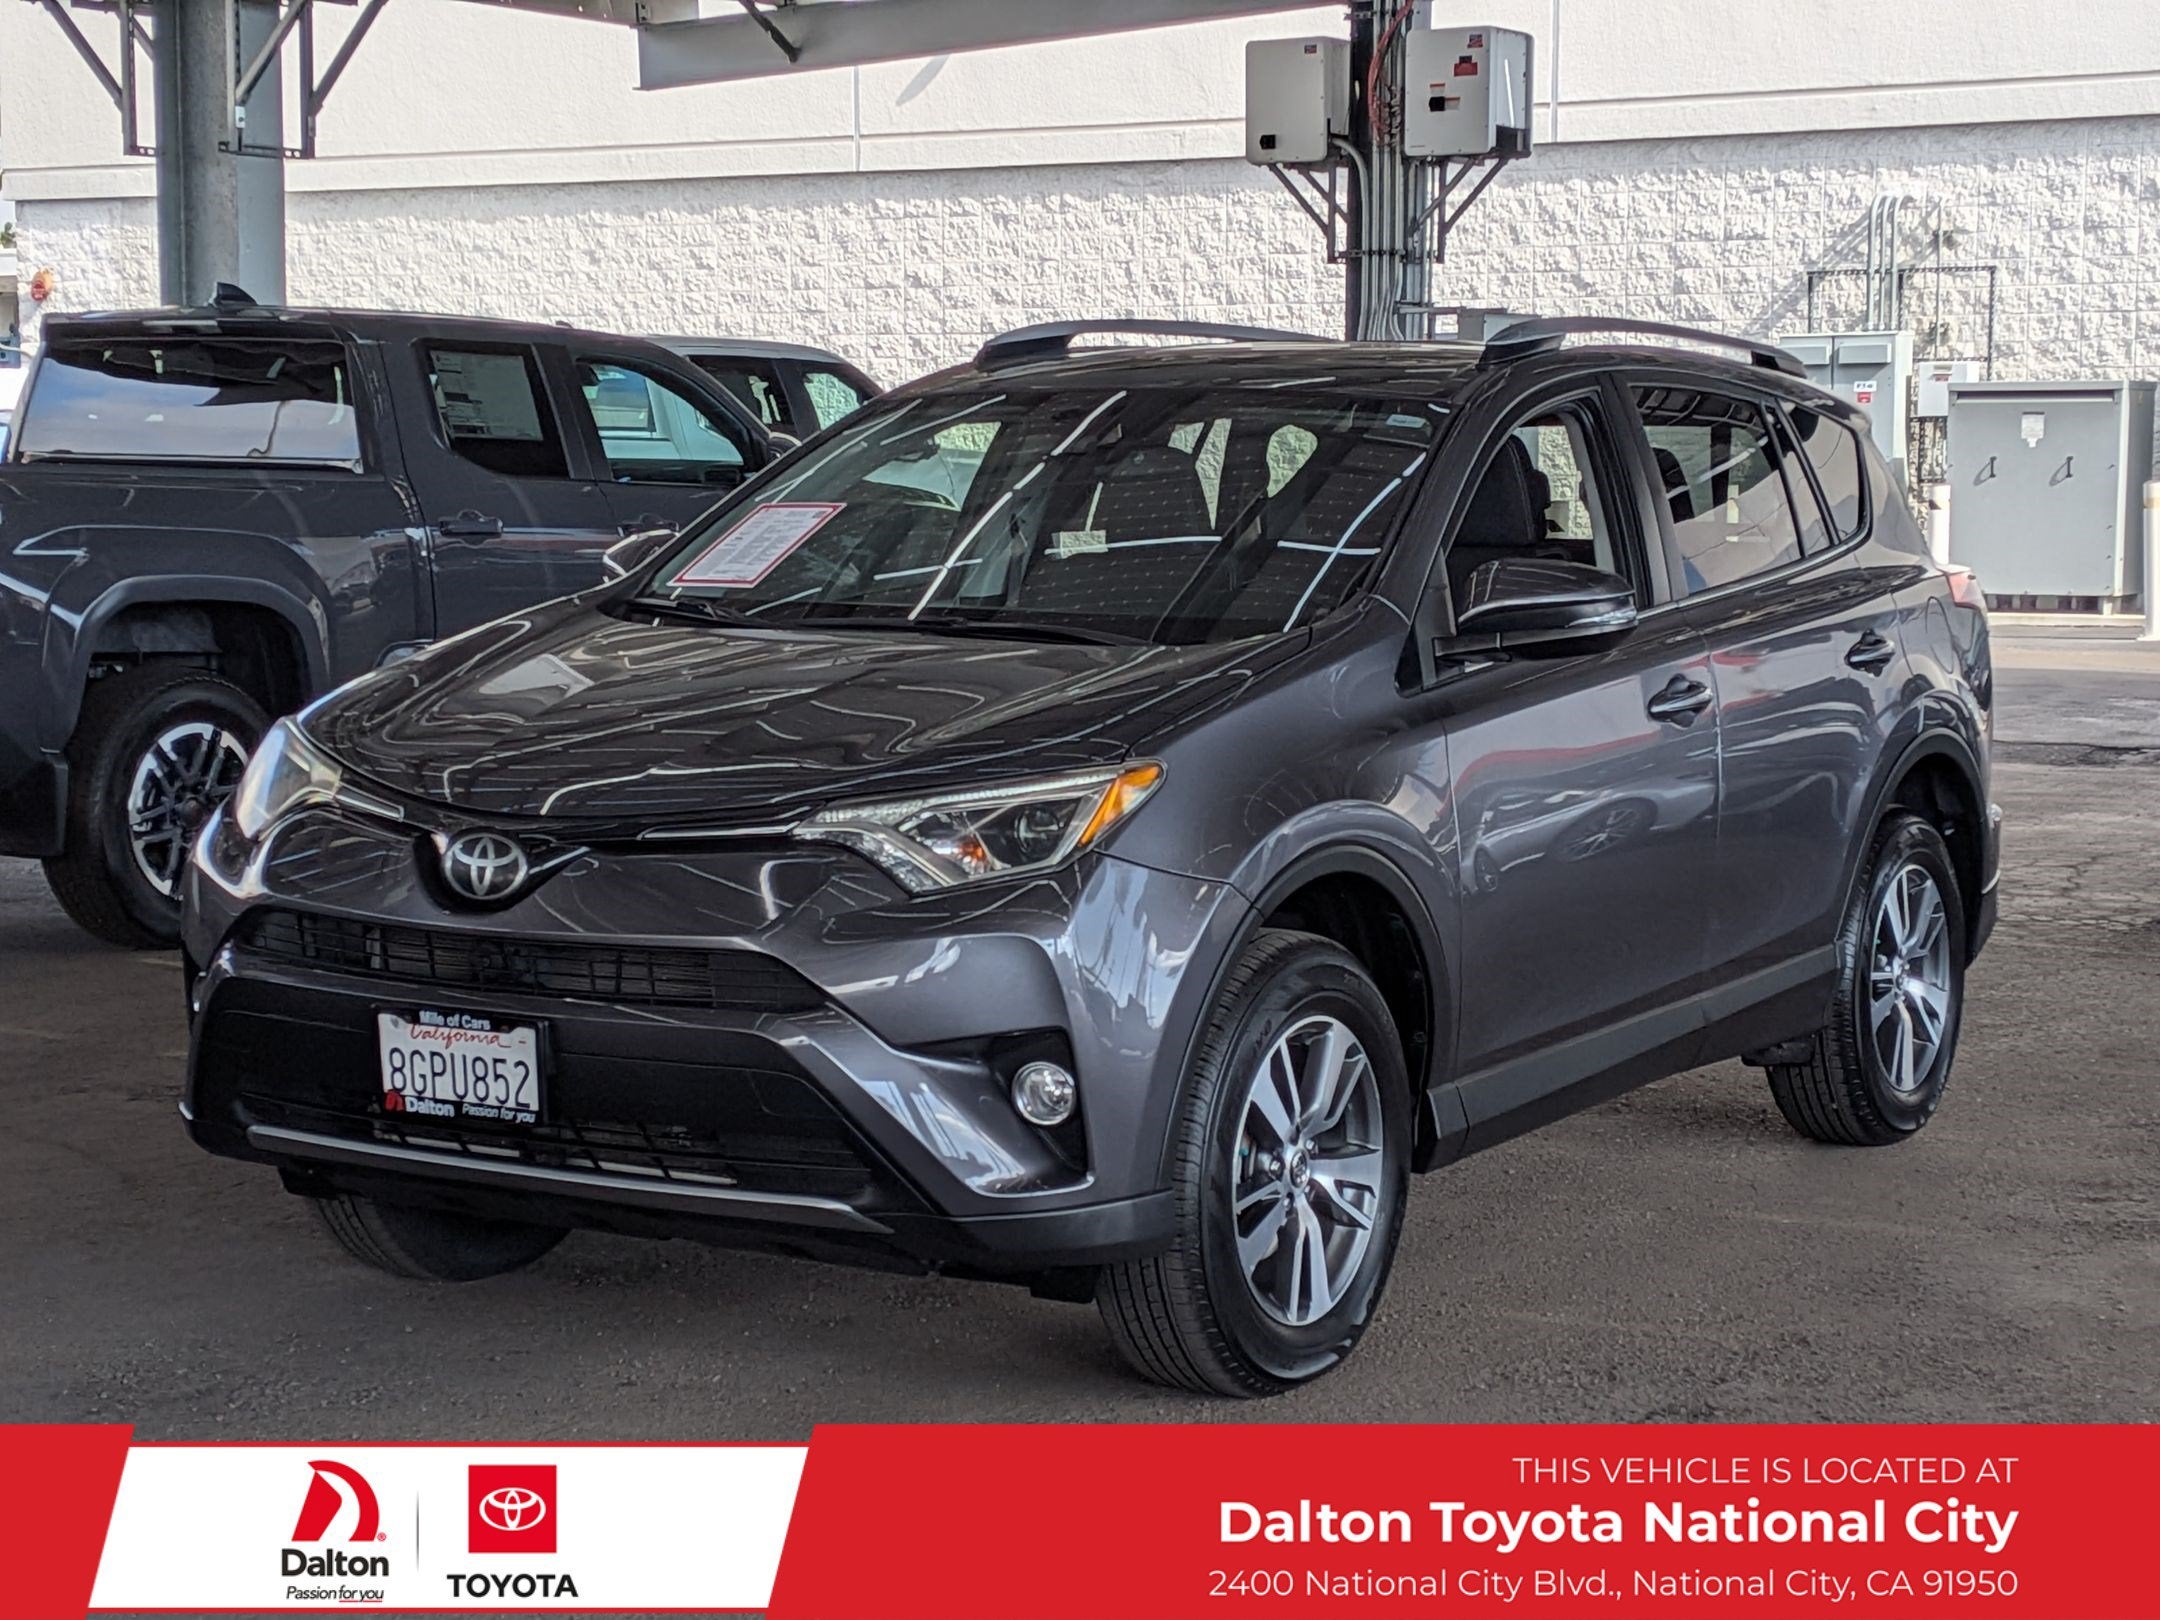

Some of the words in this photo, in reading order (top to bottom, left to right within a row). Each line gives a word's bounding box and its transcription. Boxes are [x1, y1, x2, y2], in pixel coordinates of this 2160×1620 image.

[419, 1010, 445, 1026] Mile
[446, 1014, 460, 1027] of
[461, 1016, 491, 1031] Cars
[409, 1023, 511, 1049] California
[389, 1047, 531, 1108] 8GPU852
[404, 1096, 455, 1118] Dalton
[462, 1103, 498, 1119] Passion
[500, 1105, 515, 1120] for
[515, 1111, 536, 1124] you
